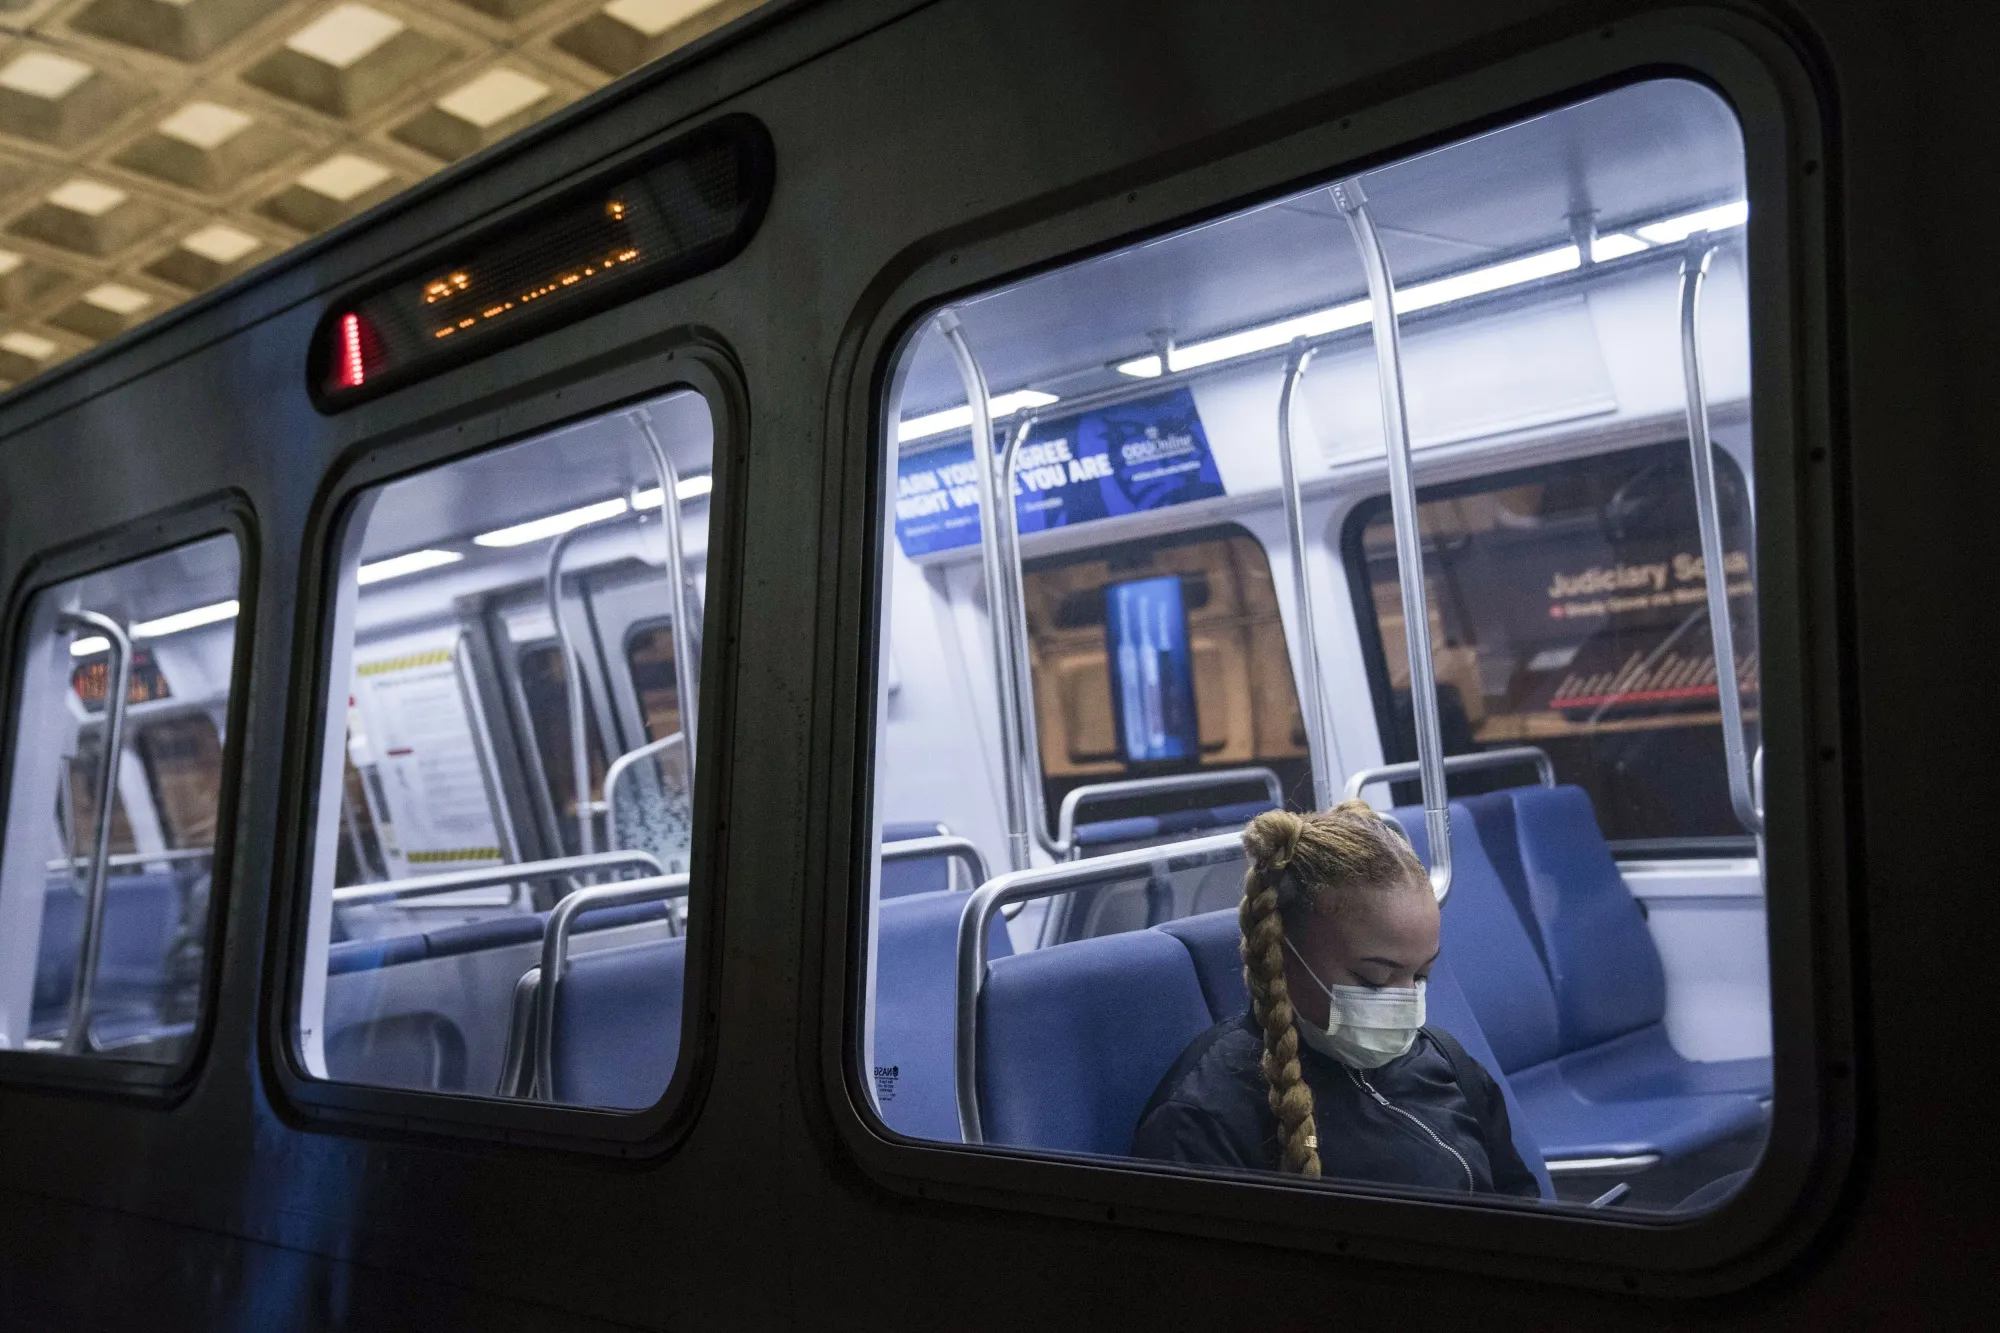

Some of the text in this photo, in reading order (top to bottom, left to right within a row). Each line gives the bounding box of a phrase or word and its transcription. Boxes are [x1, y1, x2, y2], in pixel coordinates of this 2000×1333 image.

[897, 471, 939, 498] ARN
[936, 460, 977, 489] YOU
[1019, 463, 1068, 492] YOU
[1068, 453, 1115, 483] ARE
[1548, 563, 1668, 598] Judiciary
